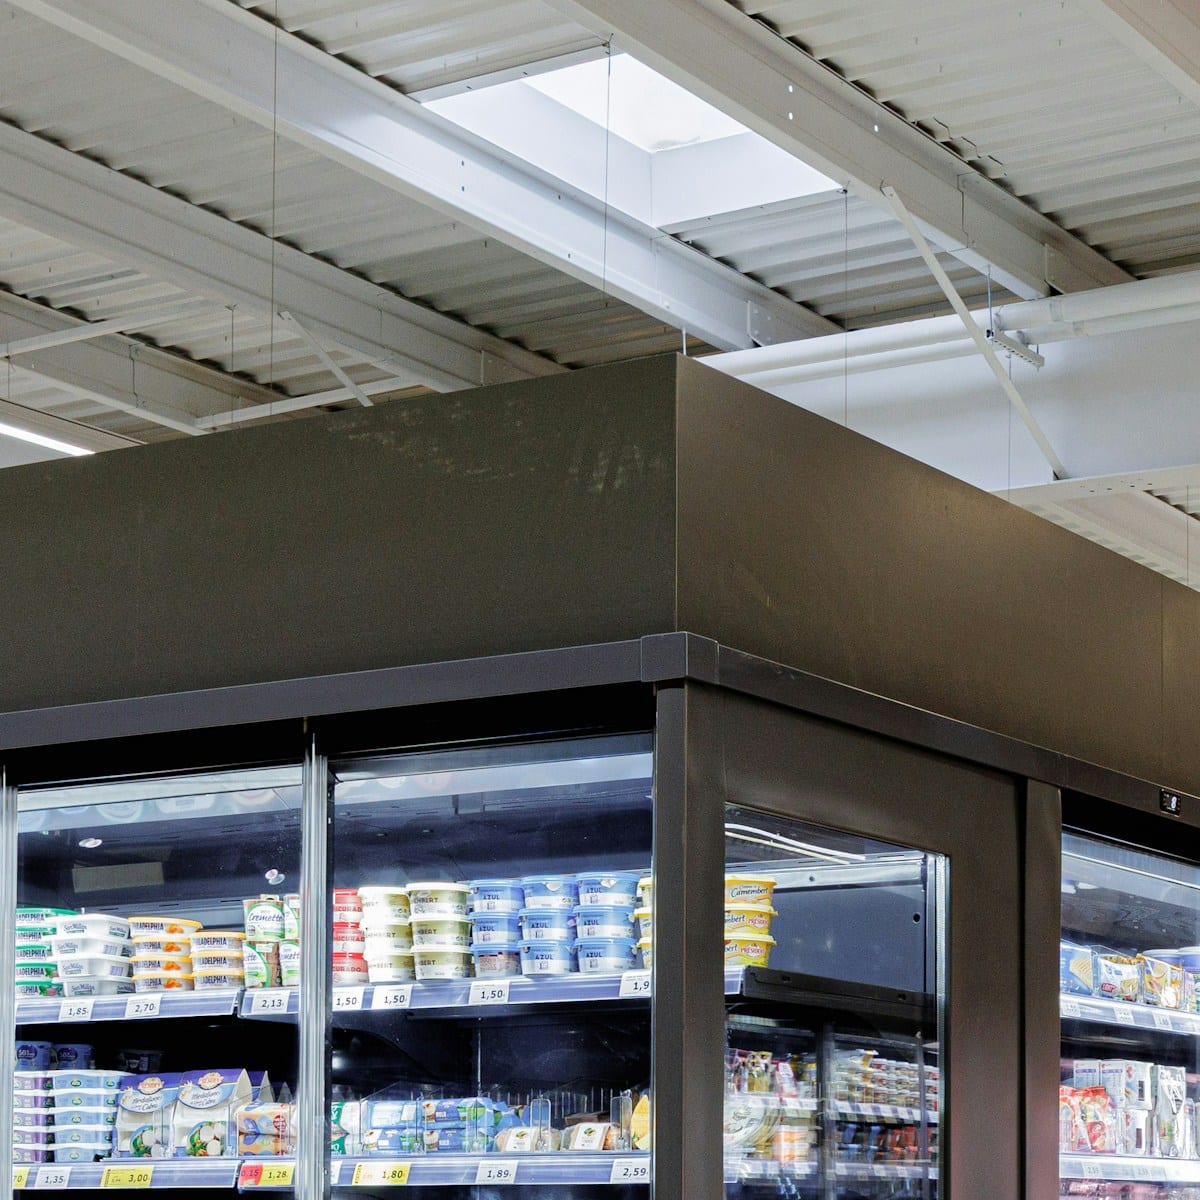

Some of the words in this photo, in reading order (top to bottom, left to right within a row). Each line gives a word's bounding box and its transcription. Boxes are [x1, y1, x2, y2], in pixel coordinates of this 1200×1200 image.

[731, 887, 769, 898] Camembert
[633, 981, 649, 991] 1,9
[384, 994, 406, 1004] 1,50
[481, 990, 503, 999] 1,50
[261, 999, 282, 1008] 2,13
[336, 996, 357, 1006] 1,50
[68, 1007, 88, 1017] 1,85
[135, 1003, 155, 1013] 2,70
[268, 1170, 288, 1179] 1,28
[382, 1170, 403, 1179] 1,80
[486, 1170, 510, 1179] 1,89
[623, 1167, 647, 1177] 2,59
[44, 1175, 64, 1184] 1,35
[128, 1174, 149, 1183] 3,00
